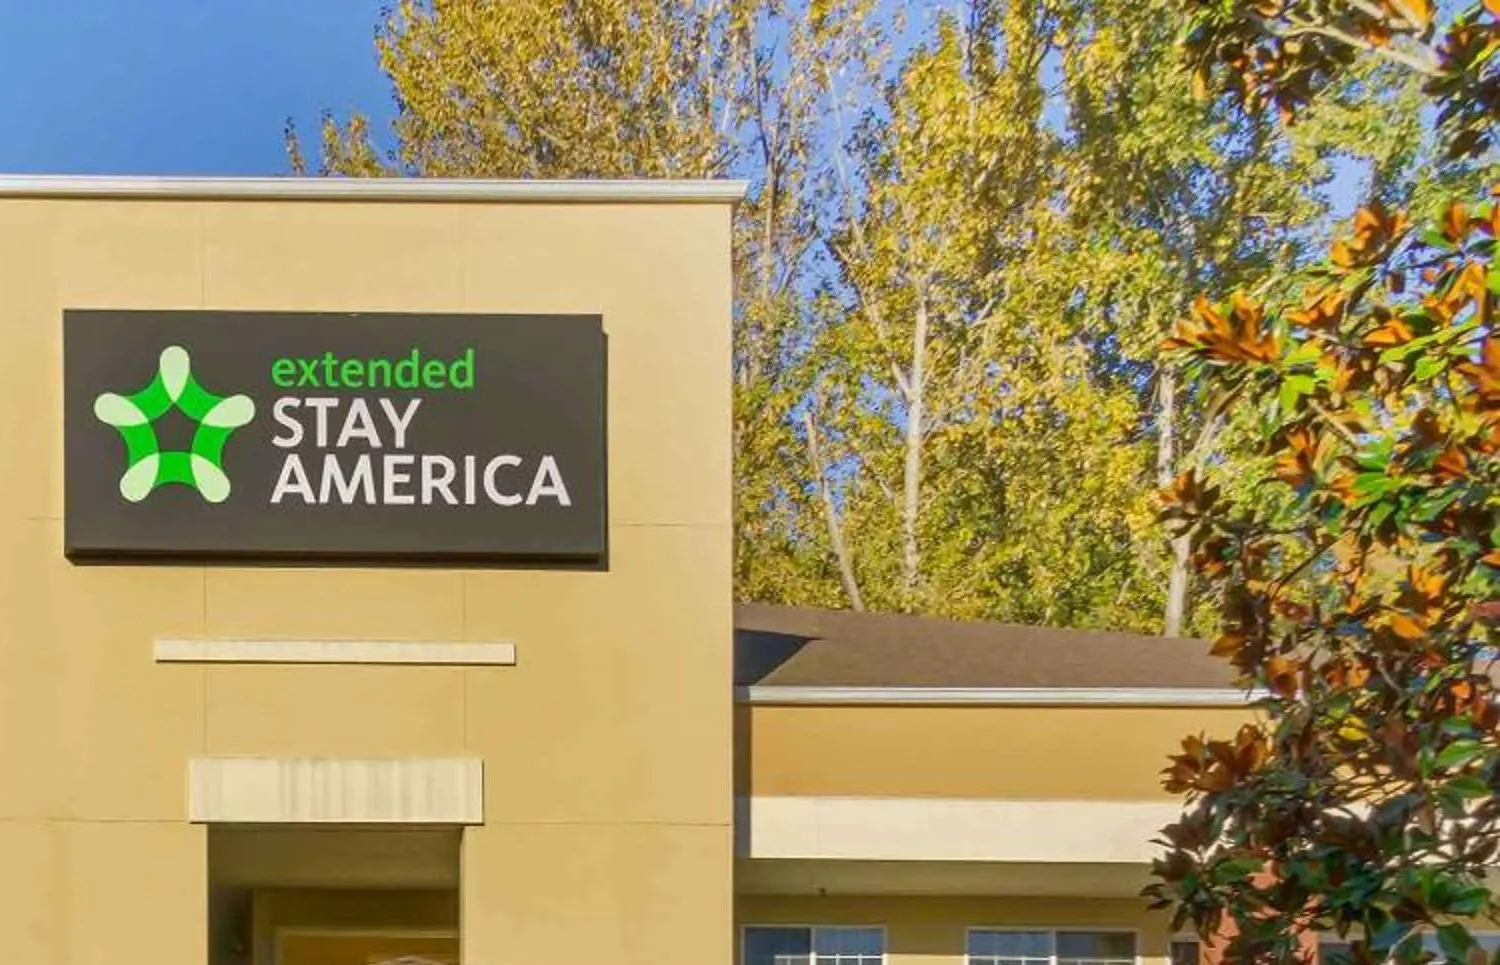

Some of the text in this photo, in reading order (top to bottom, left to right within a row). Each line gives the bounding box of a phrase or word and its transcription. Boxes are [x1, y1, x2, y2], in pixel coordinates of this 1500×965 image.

[271, 348, 475, 389] extended
[271, 397, 421, 448] STAY
[270, 454, 572, 506] AMERICA
